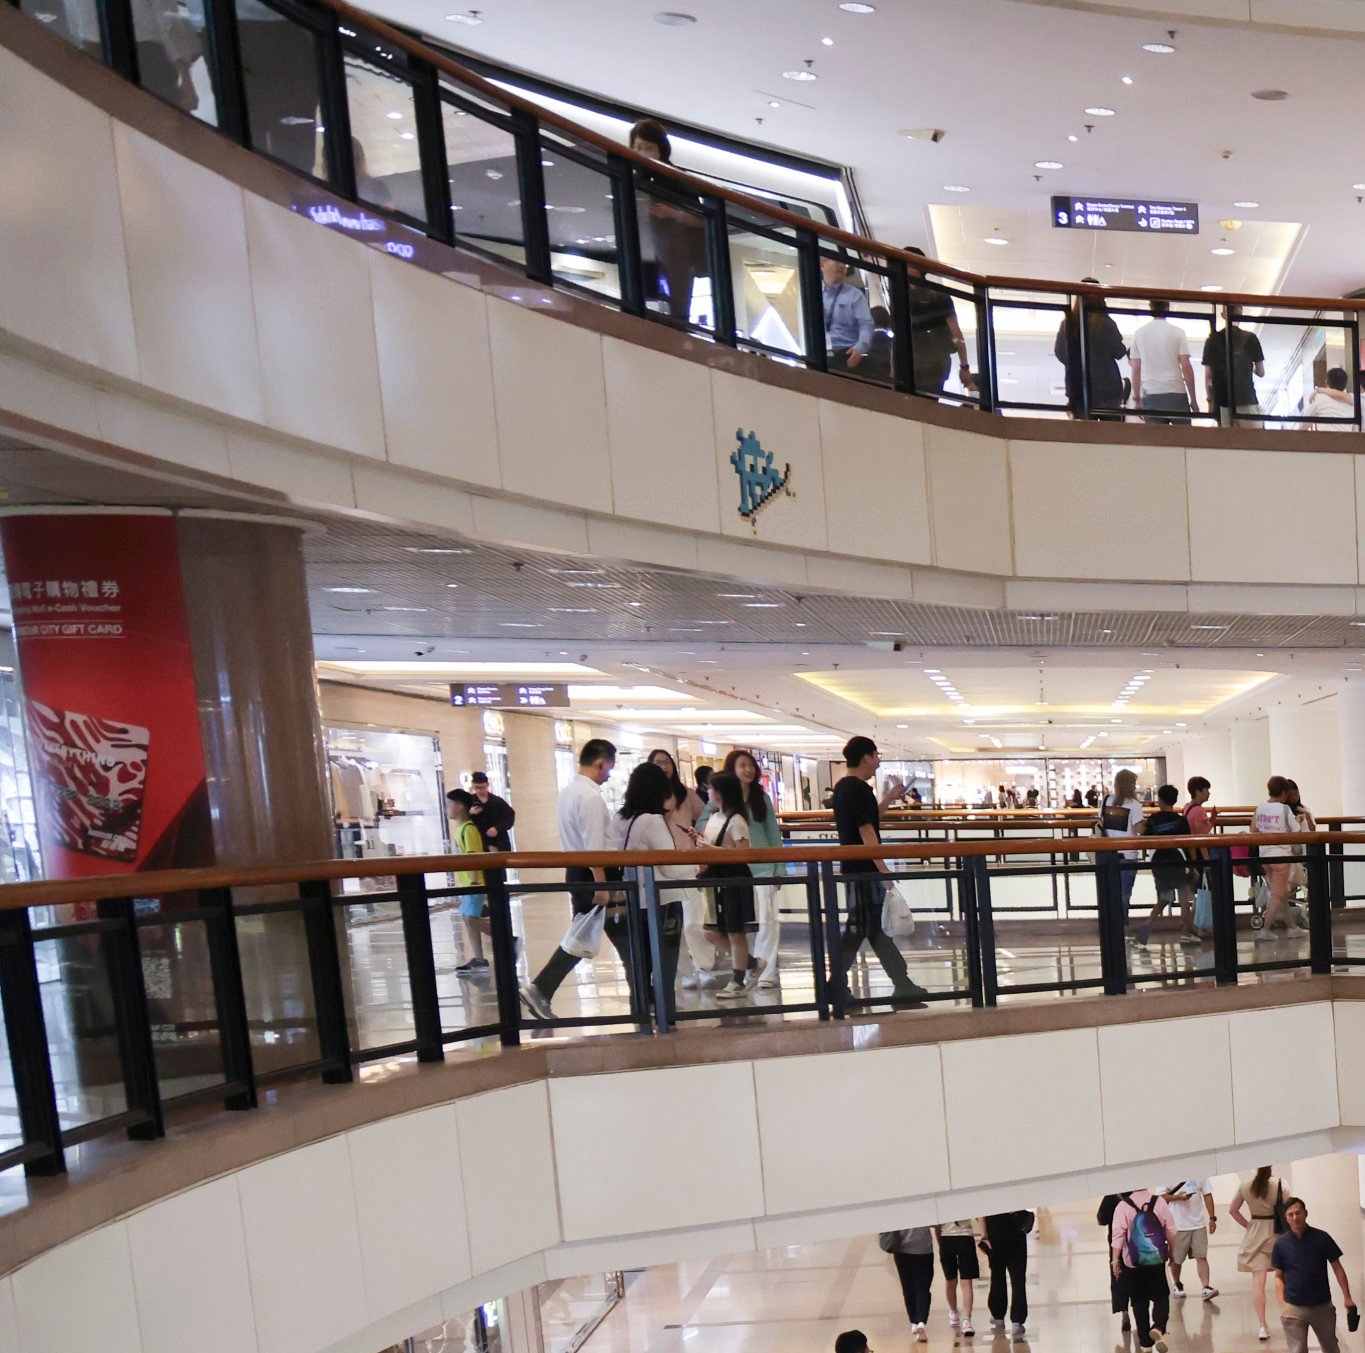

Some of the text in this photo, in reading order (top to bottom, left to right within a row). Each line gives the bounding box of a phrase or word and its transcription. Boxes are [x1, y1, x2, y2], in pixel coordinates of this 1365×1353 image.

[1058, 212, 1069, 224] 3
[61, 625, 85, 634] GIFT
[88, 624, 122, 634] CARD
[454, 695, 463, 705] 2
